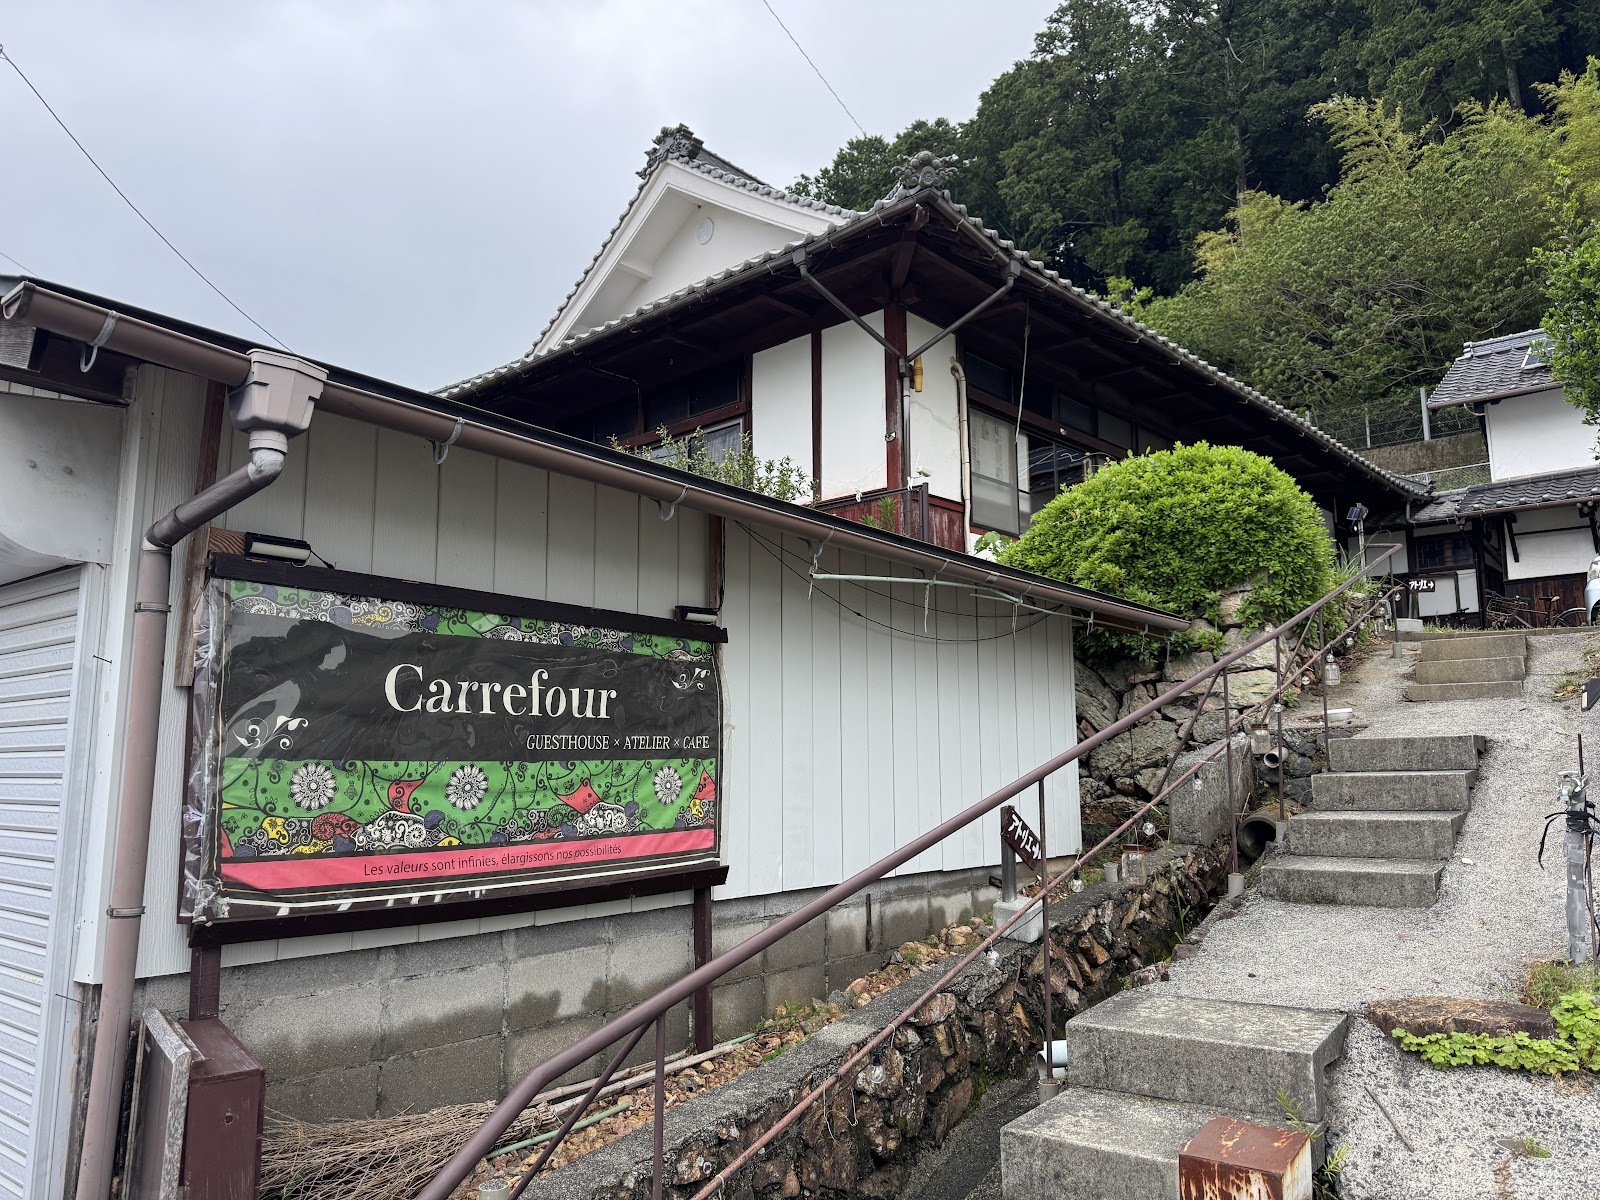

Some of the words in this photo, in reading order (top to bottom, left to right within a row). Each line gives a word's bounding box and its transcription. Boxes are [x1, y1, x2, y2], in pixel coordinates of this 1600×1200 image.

[1409, 579, 1428, 590] アトリエ
[384, 663, 617, 719] Carrefour
[526, 734, 610, 750] GUESTHOUSE
[623, 735, 670, 750] ATELIER
[683, 735, 710, 749] CAFE
[364, 863, 384, 876] Les
[387, 861, 429, 875] valeurs
[431, 858, 456, 871] sont
[458, 855, 499, 869] infinies,
[501, 851, 555, 866] élargissons
[556, 849, 573, 860] nos
[574, 844, 622, 860] possibilités
